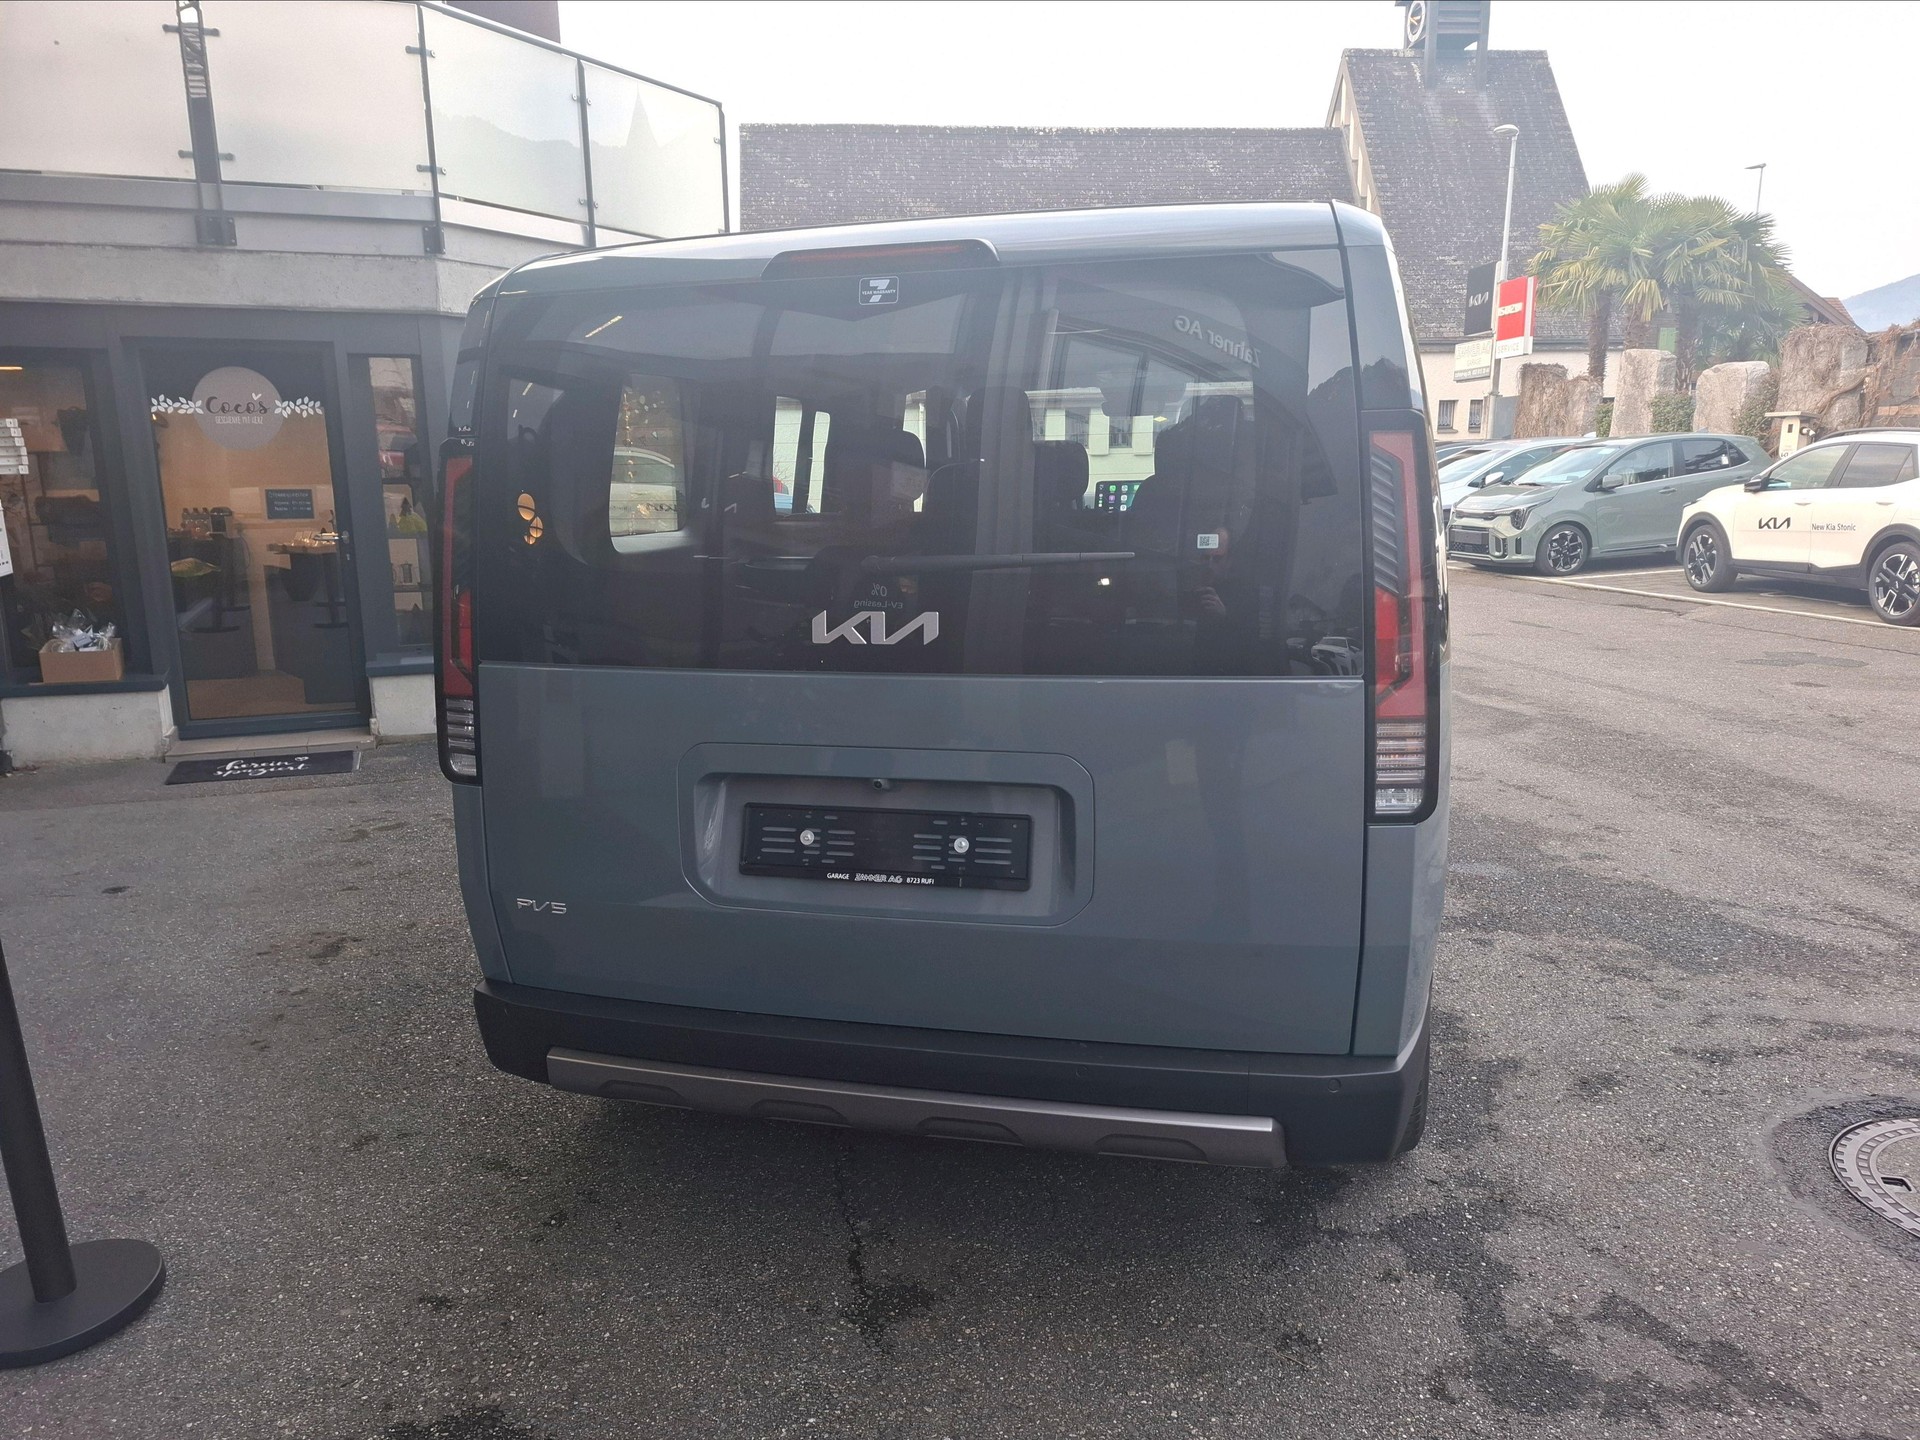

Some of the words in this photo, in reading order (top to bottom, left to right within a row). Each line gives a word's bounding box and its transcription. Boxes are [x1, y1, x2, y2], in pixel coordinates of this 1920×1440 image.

[1758, 517, 1791, 530] KIA
[1812, 523, 1825, 531] New
[1826, 523, 1836, 531] Kia
[1837, 523, 1856, 531] Stonic
[812, 610, 939, 645] KIA
[826, 872, 850, 880] GARAGE
[888, 875, 903, 884] AG
[921, 877, 935, 885] RUFI
[516, 898, 567, 915] PV5
